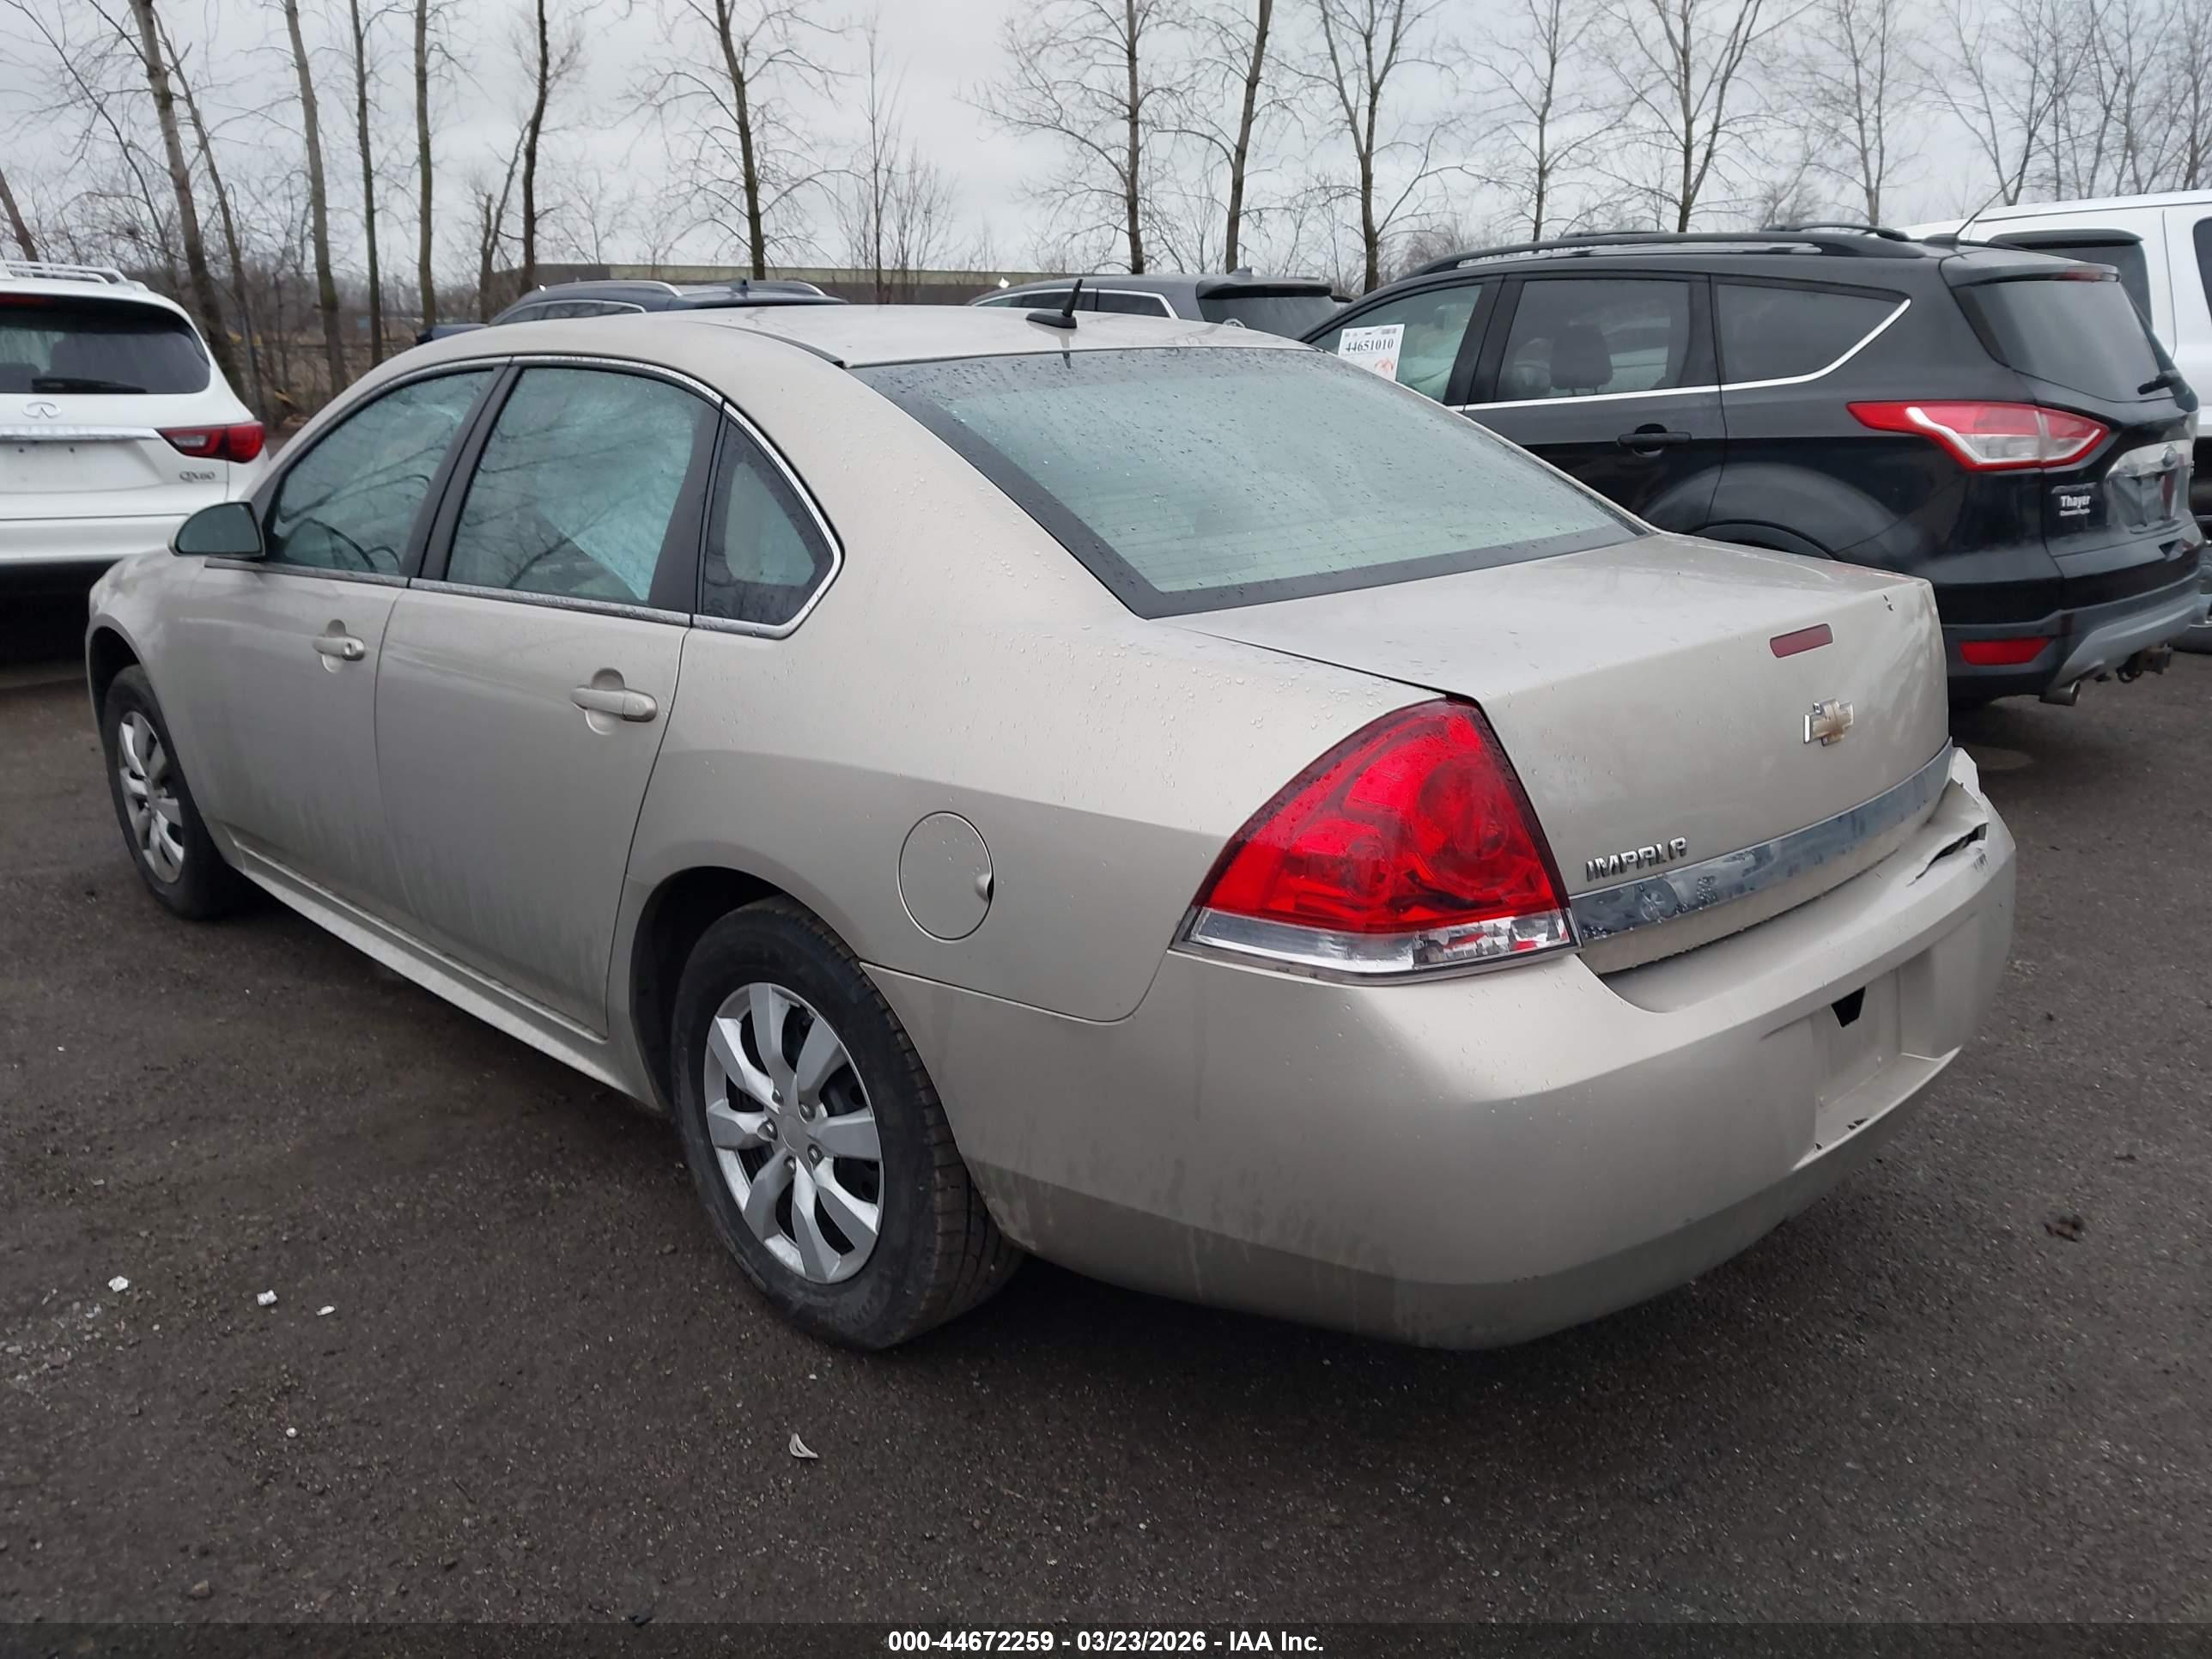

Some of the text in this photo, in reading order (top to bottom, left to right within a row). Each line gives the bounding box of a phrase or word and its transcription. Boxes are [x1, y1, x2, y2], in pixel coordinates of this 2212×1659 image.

[1345, 337, 1395, 353] 44651010
[2060, 495, 2091, 508] Thayer
[1587, 836, 1686, 882] IMPALA
